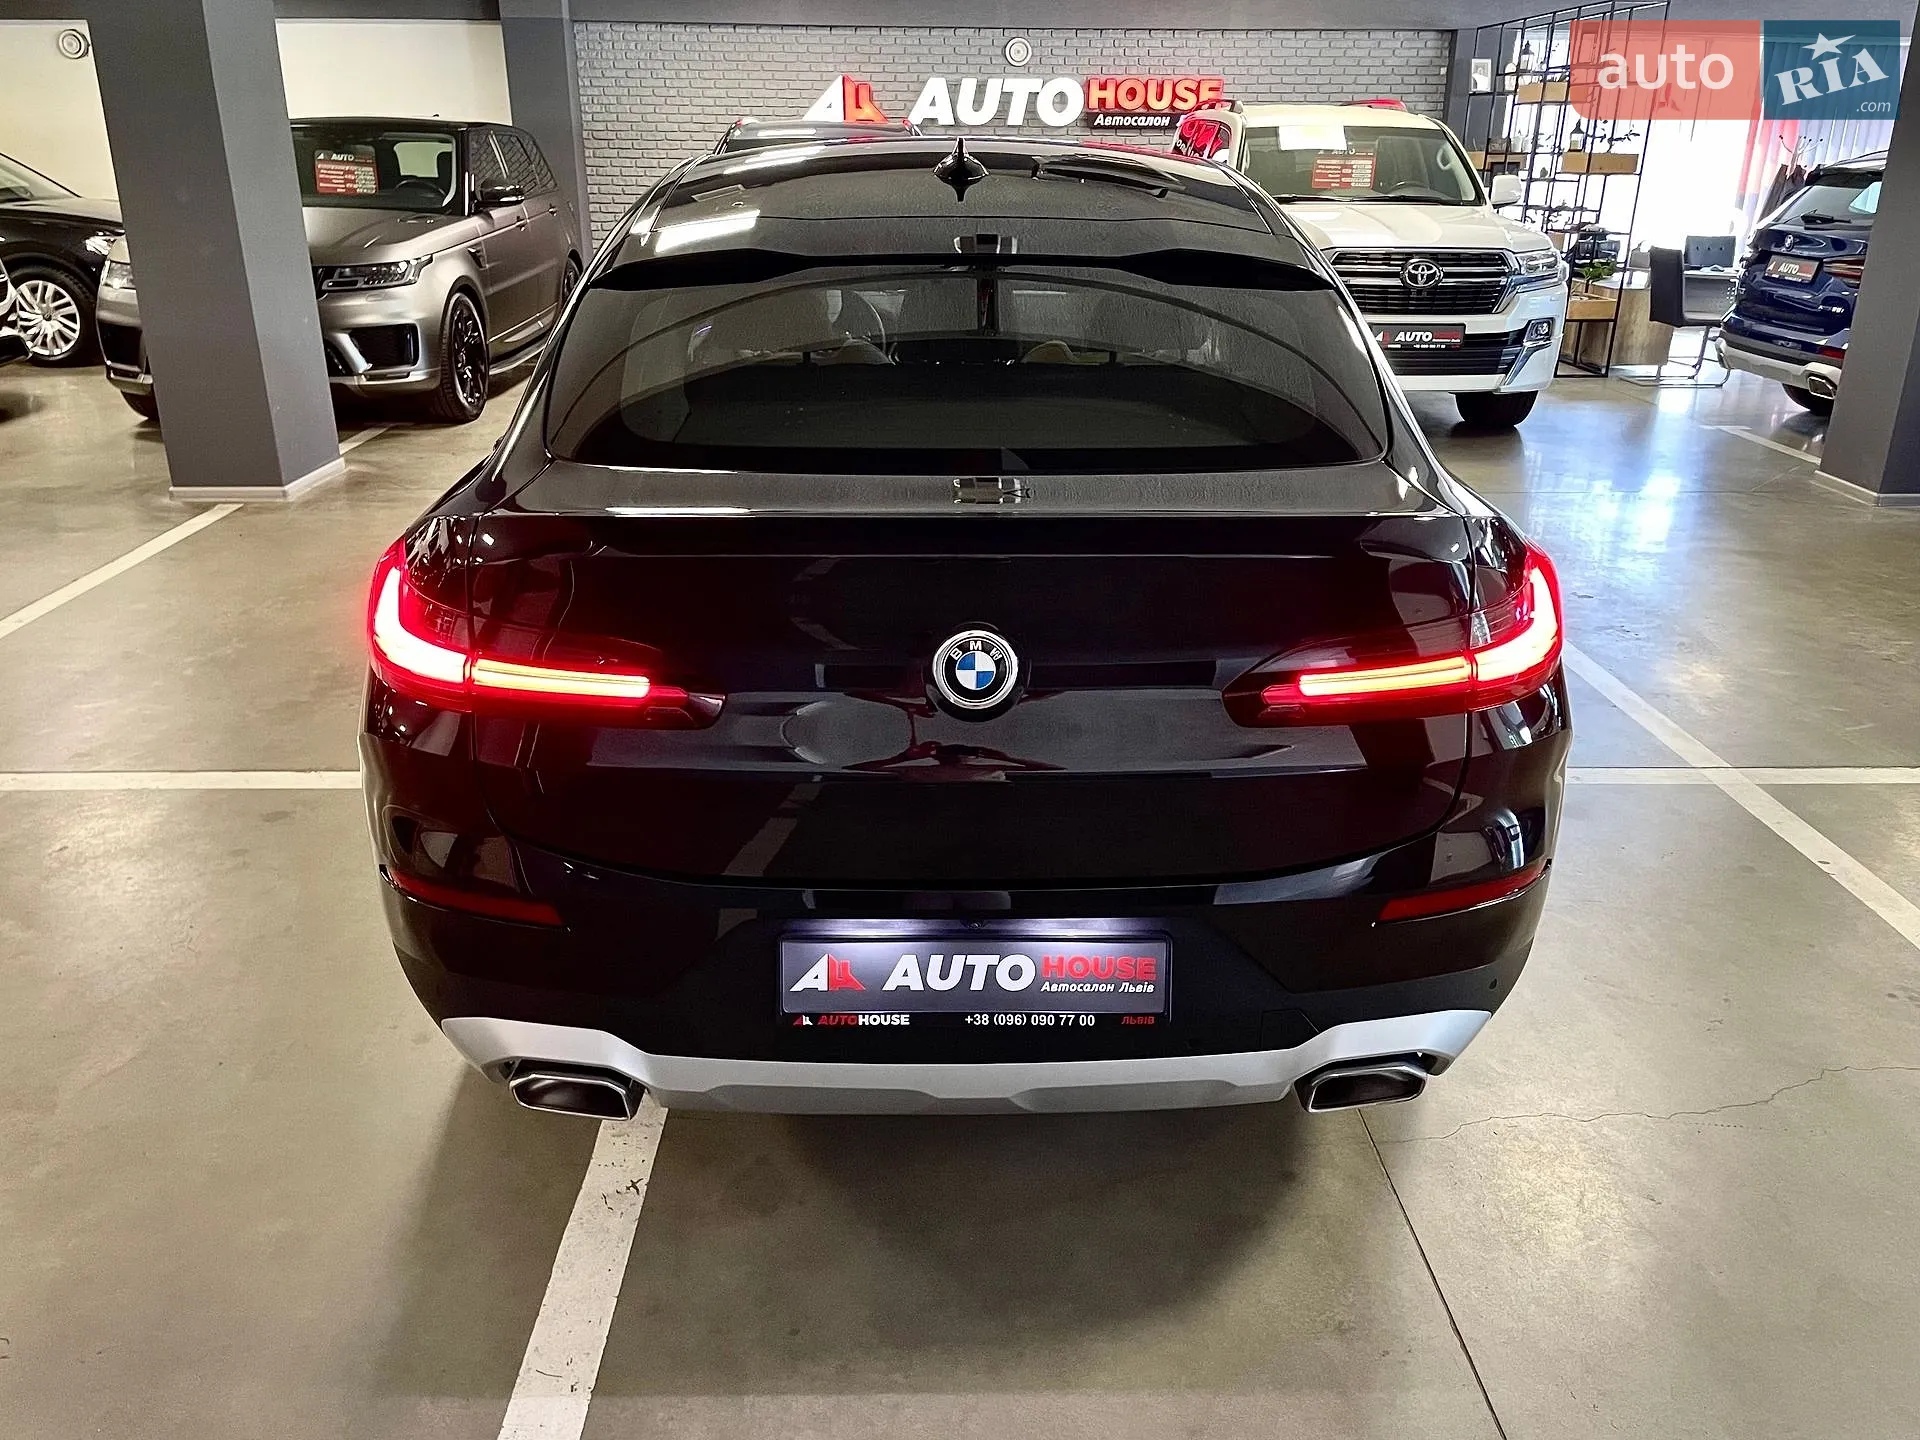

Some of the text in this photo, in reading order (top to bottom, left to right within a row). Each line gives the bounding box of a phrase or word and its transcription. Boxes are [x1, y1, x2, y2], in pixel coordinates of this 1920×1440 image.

[907, 77, 1085, 127] AUTO
[1087, 78, 1224, 111] HOUSE
[1094, 114, 1171, 127] Автосалон
[1778, 263, 1801, 275] AUTO
[1394, 331, 1433, 342] AUTO
[949, 640, 1003, 661] BMW
[881, 953, 1036, 992] AUTO
[1041, 955, 1157, 981] HOUSE
[1040, 981, 1155, 993] Автосалон Львів
[818, 1013, 1096, 1027] AUTOHOUSE +38 (096) 090 77 00
